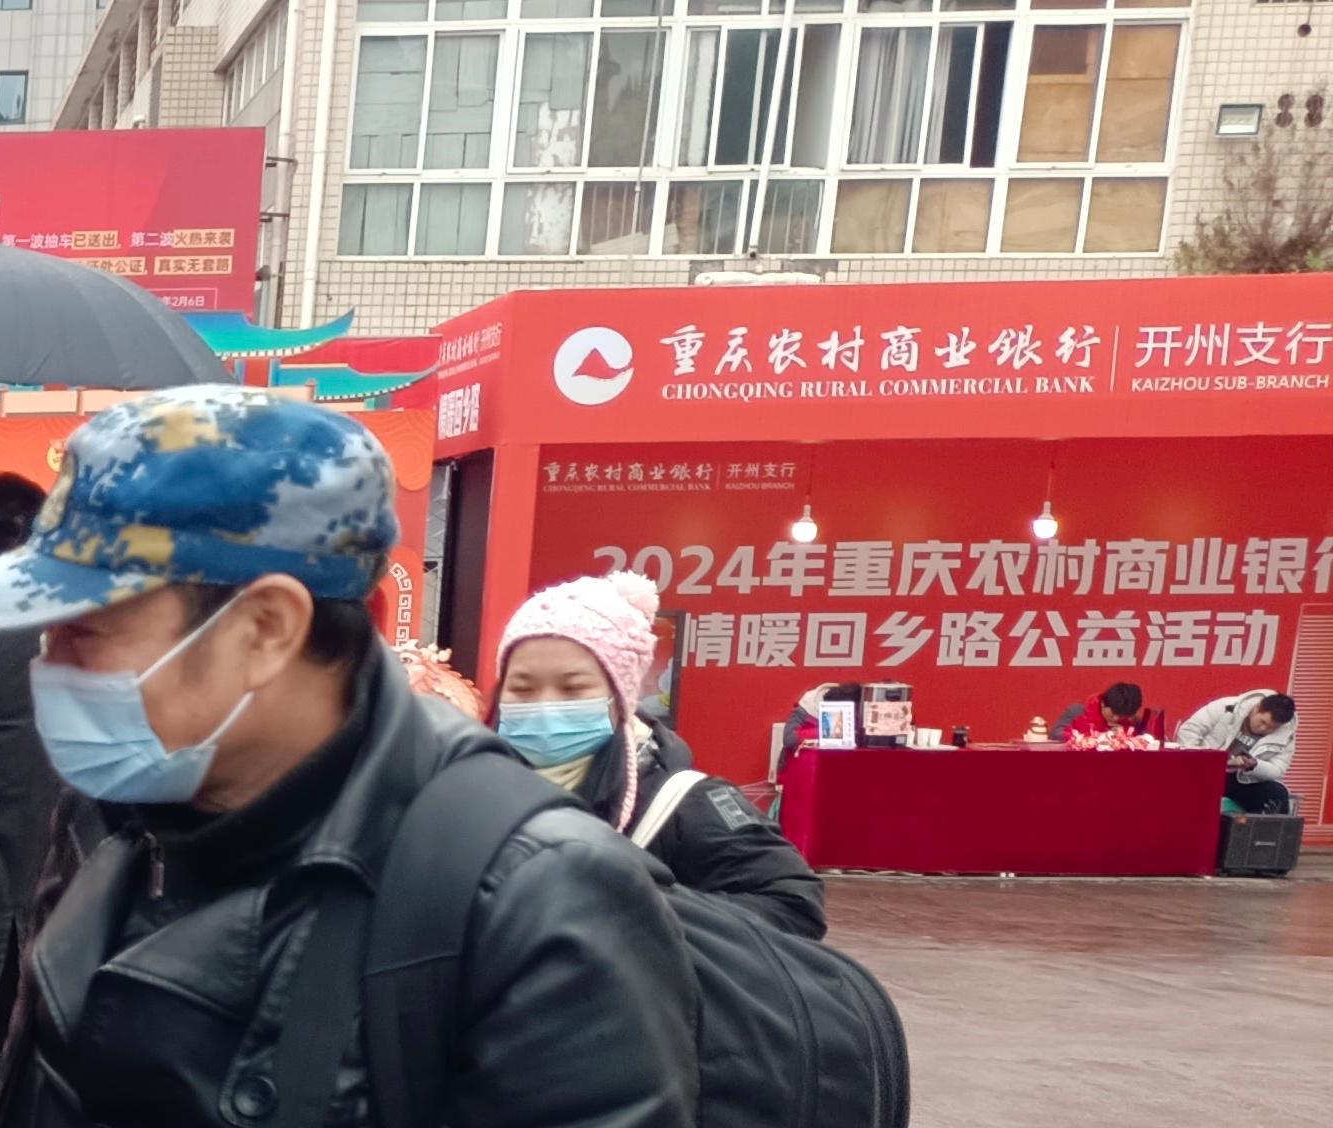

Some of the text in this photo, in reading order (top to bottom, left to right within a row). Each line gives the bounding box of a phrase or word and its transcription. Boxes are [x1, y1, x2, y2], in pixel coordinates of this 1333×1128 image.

[659, 321, 1333, 377] 重庆农村商业银行 开州支行
[661, 374, 1329, 402] CHONGQING RURAL COMMERCIAL BANK KAIZHOU SUB-BRANCH
[543, 461, 797, 483] 重庆农村商业银行 开州支行
[687, 483, 712, 491] BANK
[683, 609, 1281, 669] 情暖回乡路公益活动
